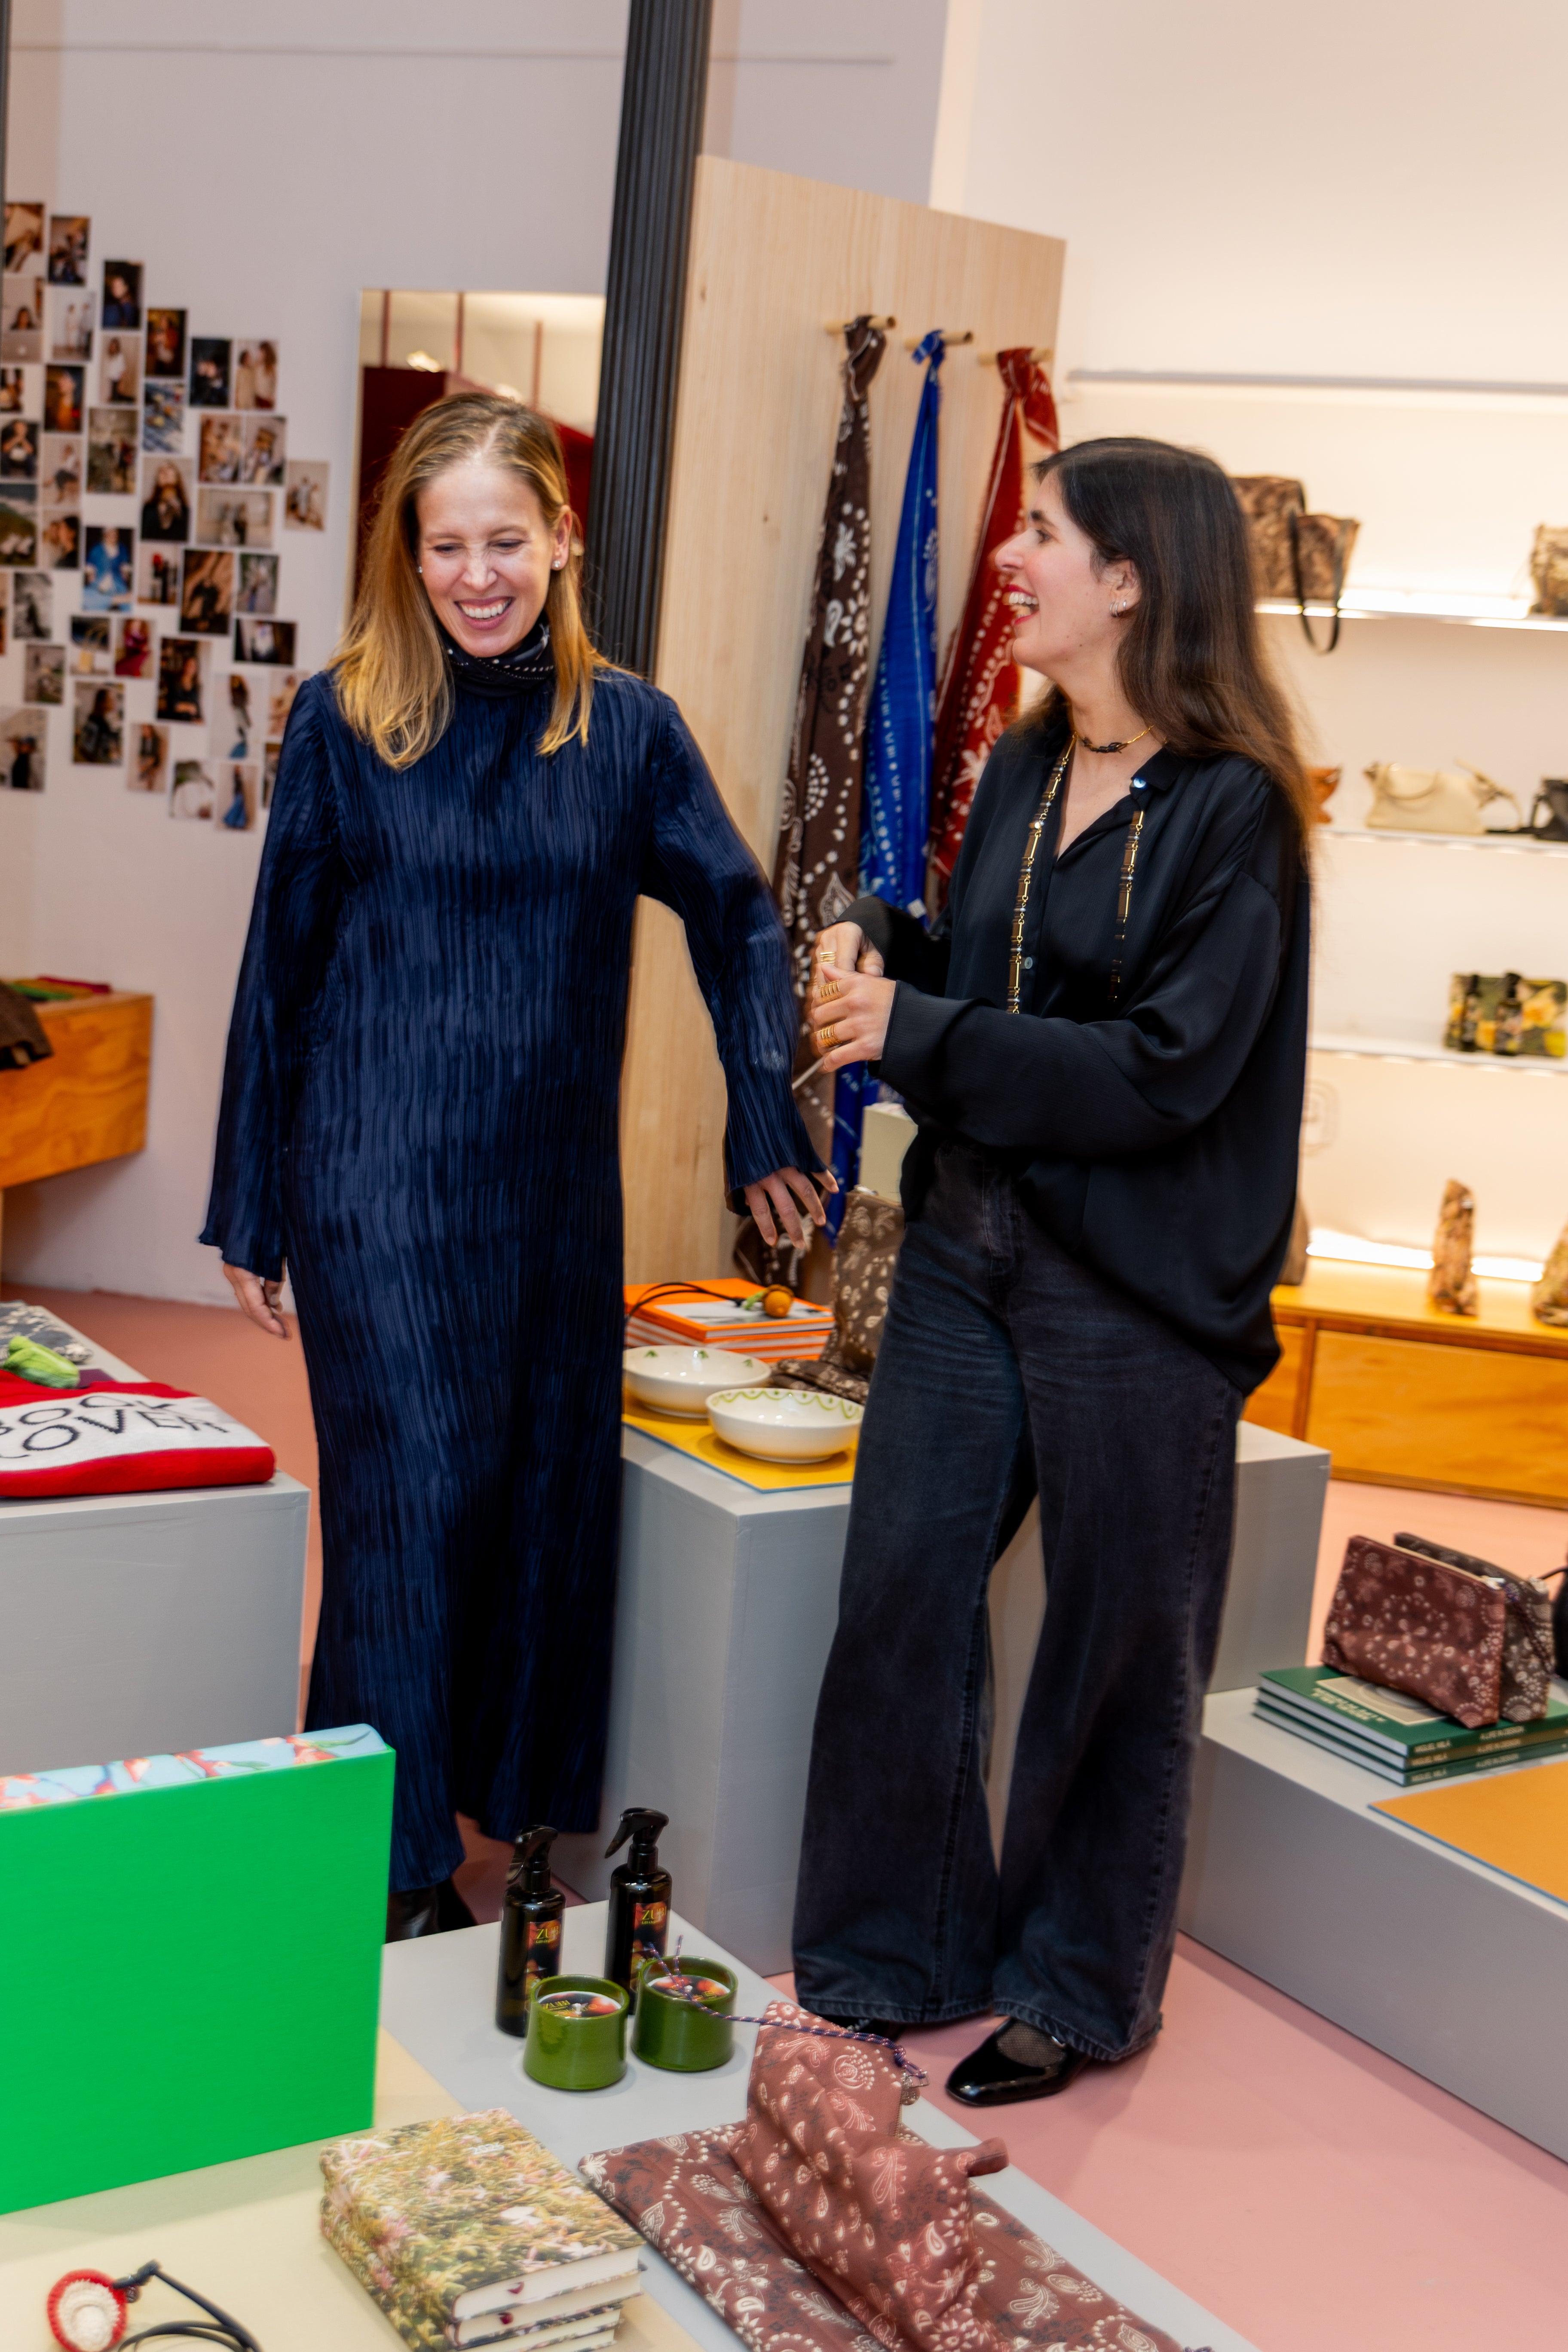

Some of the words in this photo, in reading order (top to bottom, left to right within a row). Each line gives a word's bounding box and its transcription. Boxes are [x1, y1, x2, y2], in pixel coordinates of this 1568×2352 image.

[0, 1396, 178, 1436] OOK
[642, 1905, 667, 1920] ZUBI
[536, 1924, 561, 1939] ZUBI
